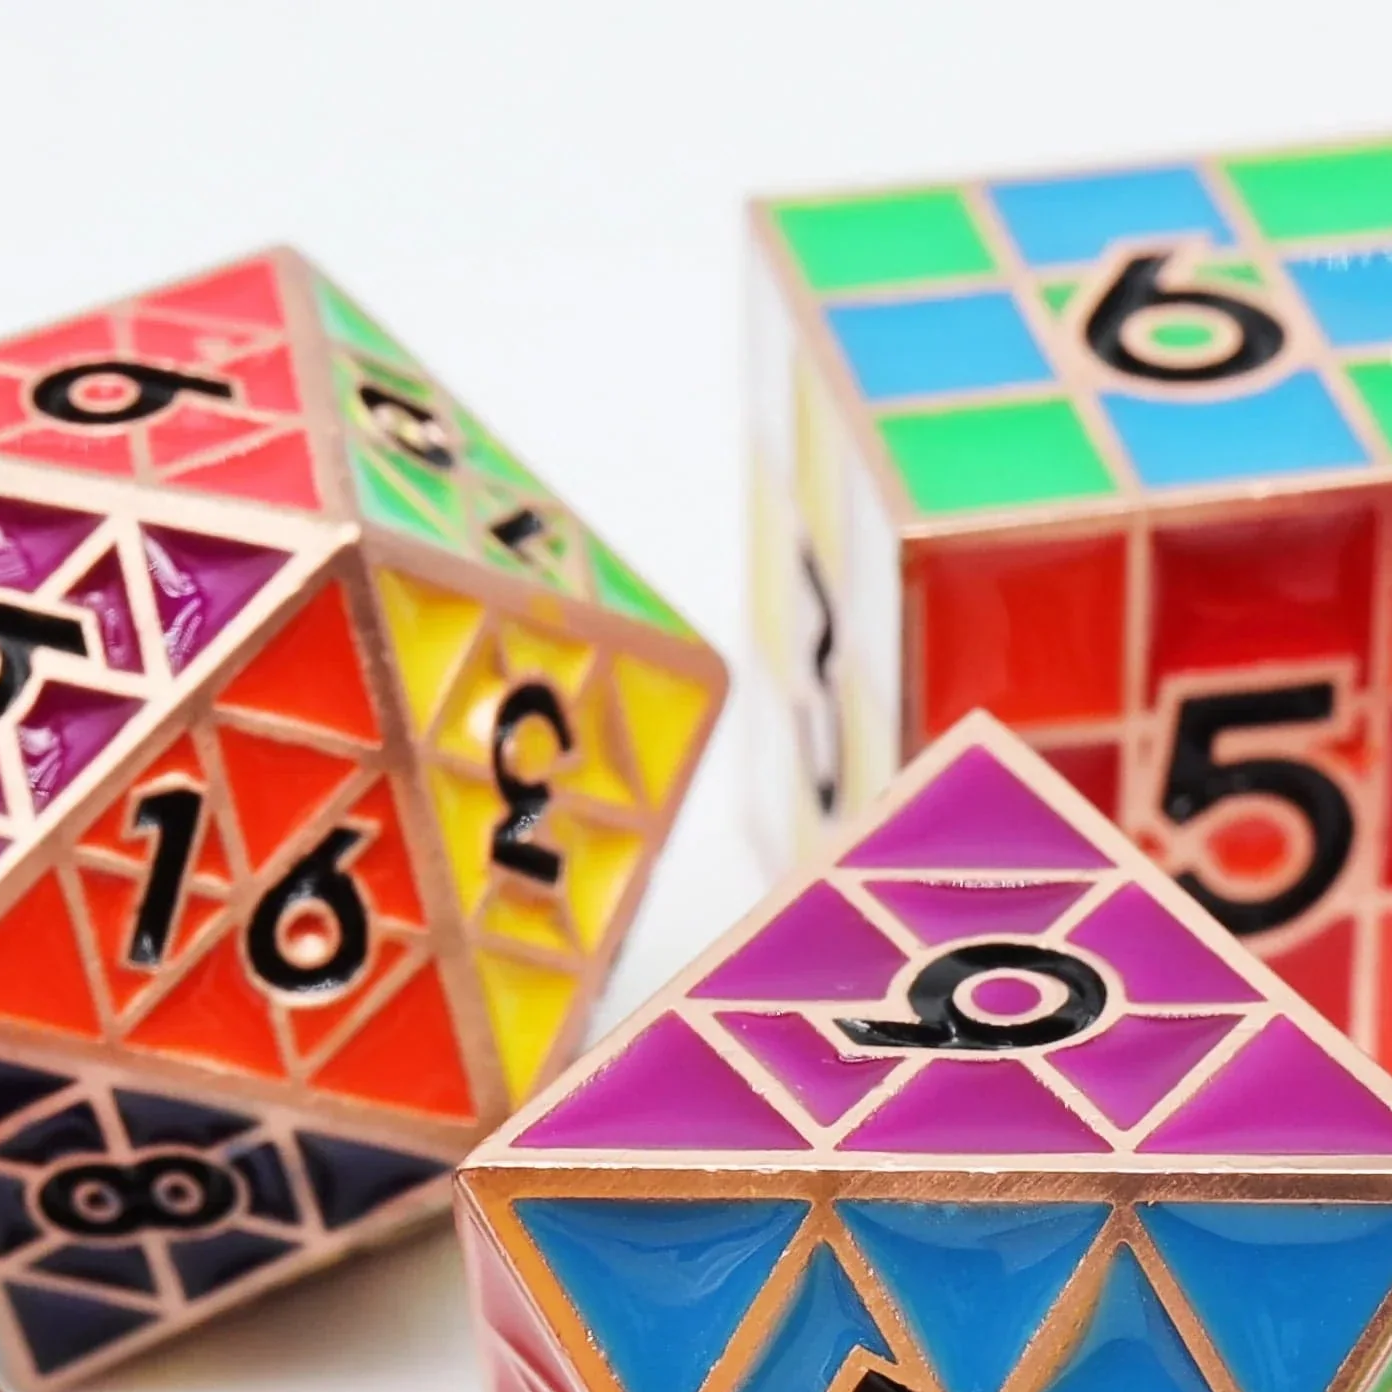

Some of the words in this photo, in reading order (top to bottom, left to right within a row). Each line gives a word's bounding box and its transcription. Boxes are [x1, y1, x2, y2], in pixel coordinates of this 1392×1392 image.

[1085, 250, 1286, 382] 6
[489, 684, 572, 884] 3
[1161, 681, 1355, 936] 5
[128, 787, 370, 992] 16
[36, 1151, 238, 1235] 8
